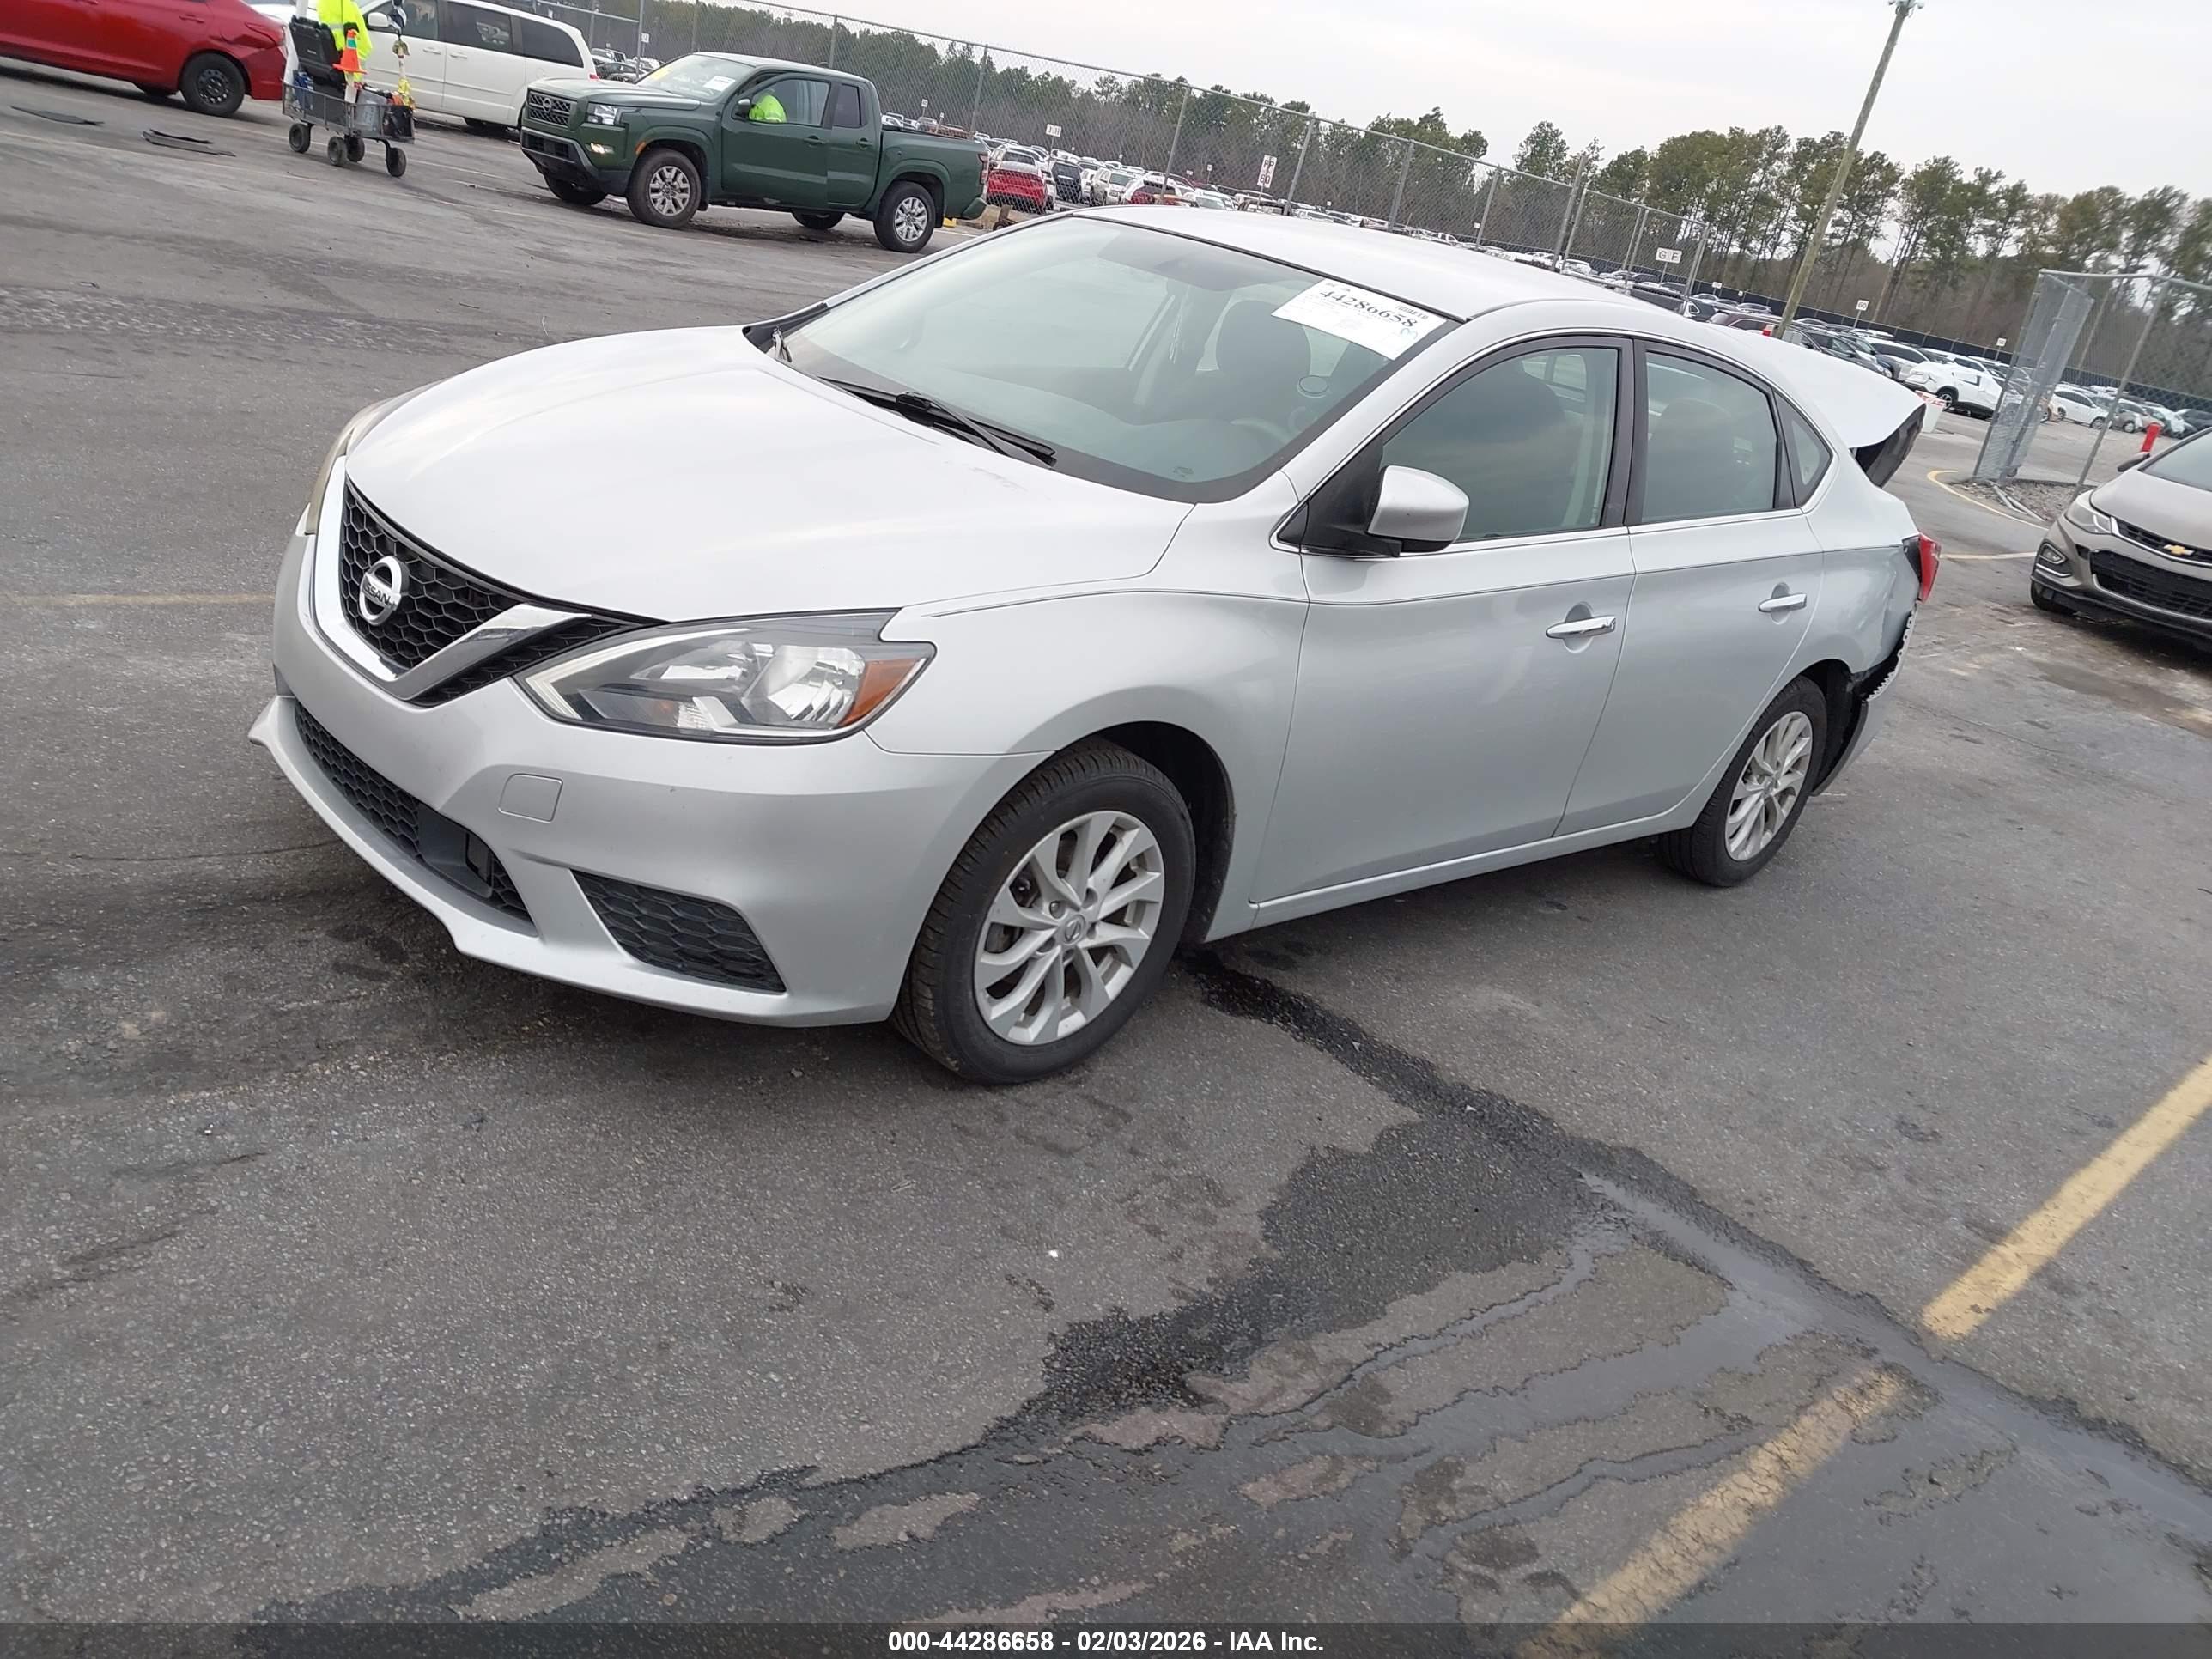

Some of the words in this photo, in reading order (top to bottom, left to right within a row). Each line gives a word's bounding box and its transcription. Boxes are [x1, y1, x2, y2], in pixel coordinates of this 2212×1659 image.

[1658, 250, 1668, 259] G
[1671, 252, 1679, 261] F
[1320, 291, 1418, 327] 44286658
